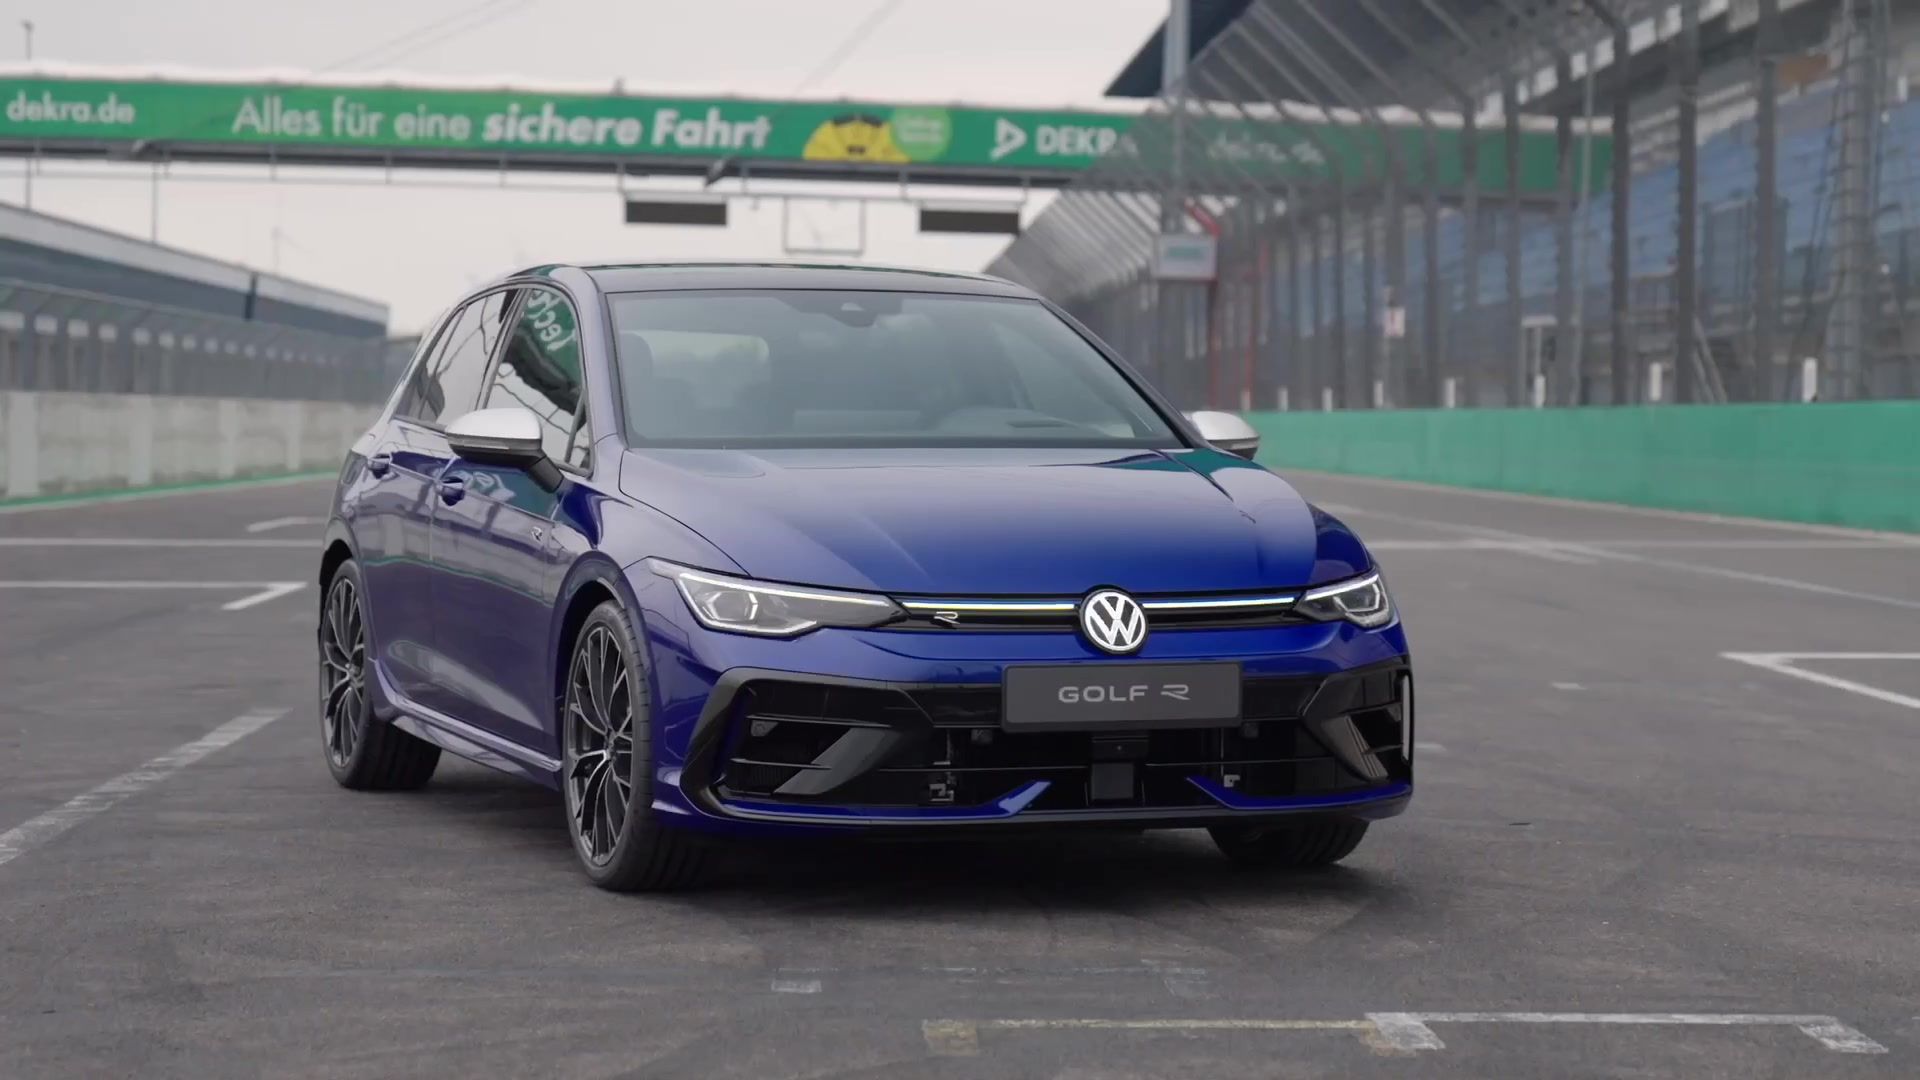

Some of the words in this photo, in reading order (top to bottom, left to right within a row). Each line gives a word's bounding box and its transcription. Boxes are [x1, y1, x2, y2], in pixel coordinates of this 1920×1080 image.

[6, 88, 136, 124] dekra.de
[231, 95, 322, 137] Alles
[332, 96, 384, 138] für
[394, 103, 472, 141] eine
[482, 102, 642, 146] sichere
[651, 107, 772, 150] Fahrt
[1083, 589, 1148, 652] VW
[1058, 685, 1148, 703] GOLF
[1160, 684, 1191, 701] R
